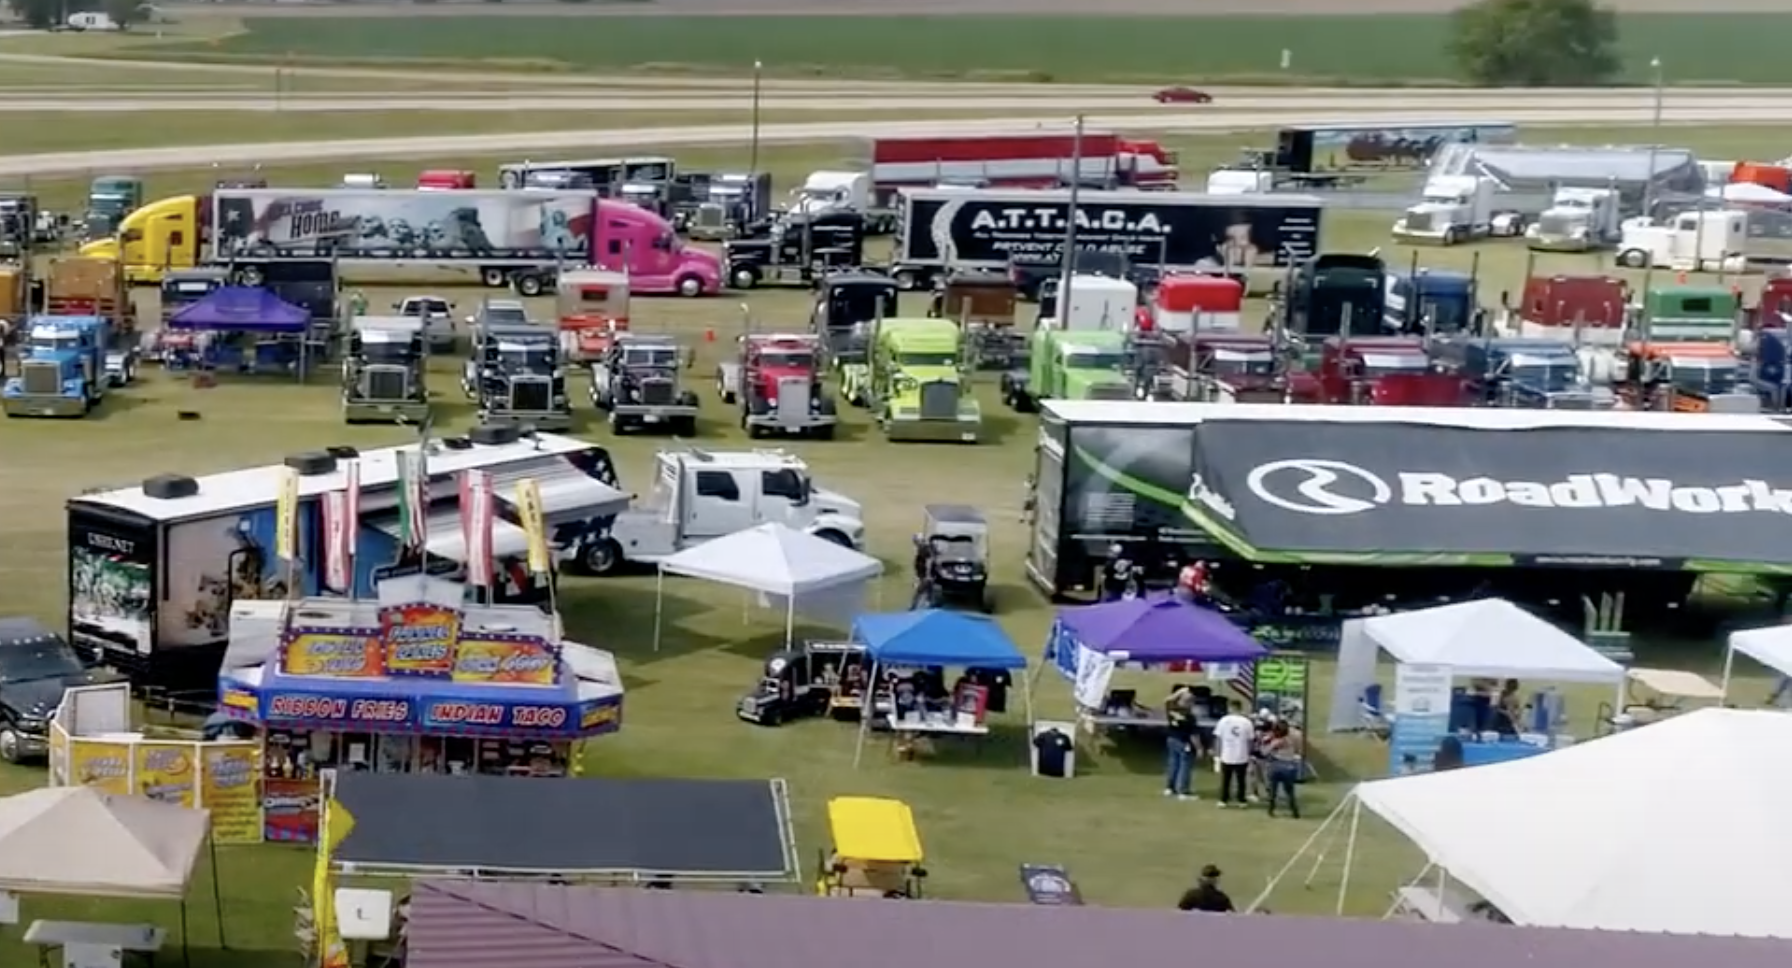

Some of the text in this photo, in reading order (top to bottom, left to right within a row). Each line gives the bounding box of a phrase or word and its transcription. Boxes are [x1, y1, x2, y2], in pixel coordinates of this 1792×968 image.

[290, 210, 340, 239] HOME
[971, 208, 1173, 233] A.T.T.A.C.A.
[1055, 242, 1096, 252] CILD
[1398, 472, 1792, 515] RoadWork
[272, 696, 346, 719] RIBBON
[351, 700, 408, 721] FRIES
[431, 704, 504, 723] INDIAN
[512, 706, 566, 728] TACO
